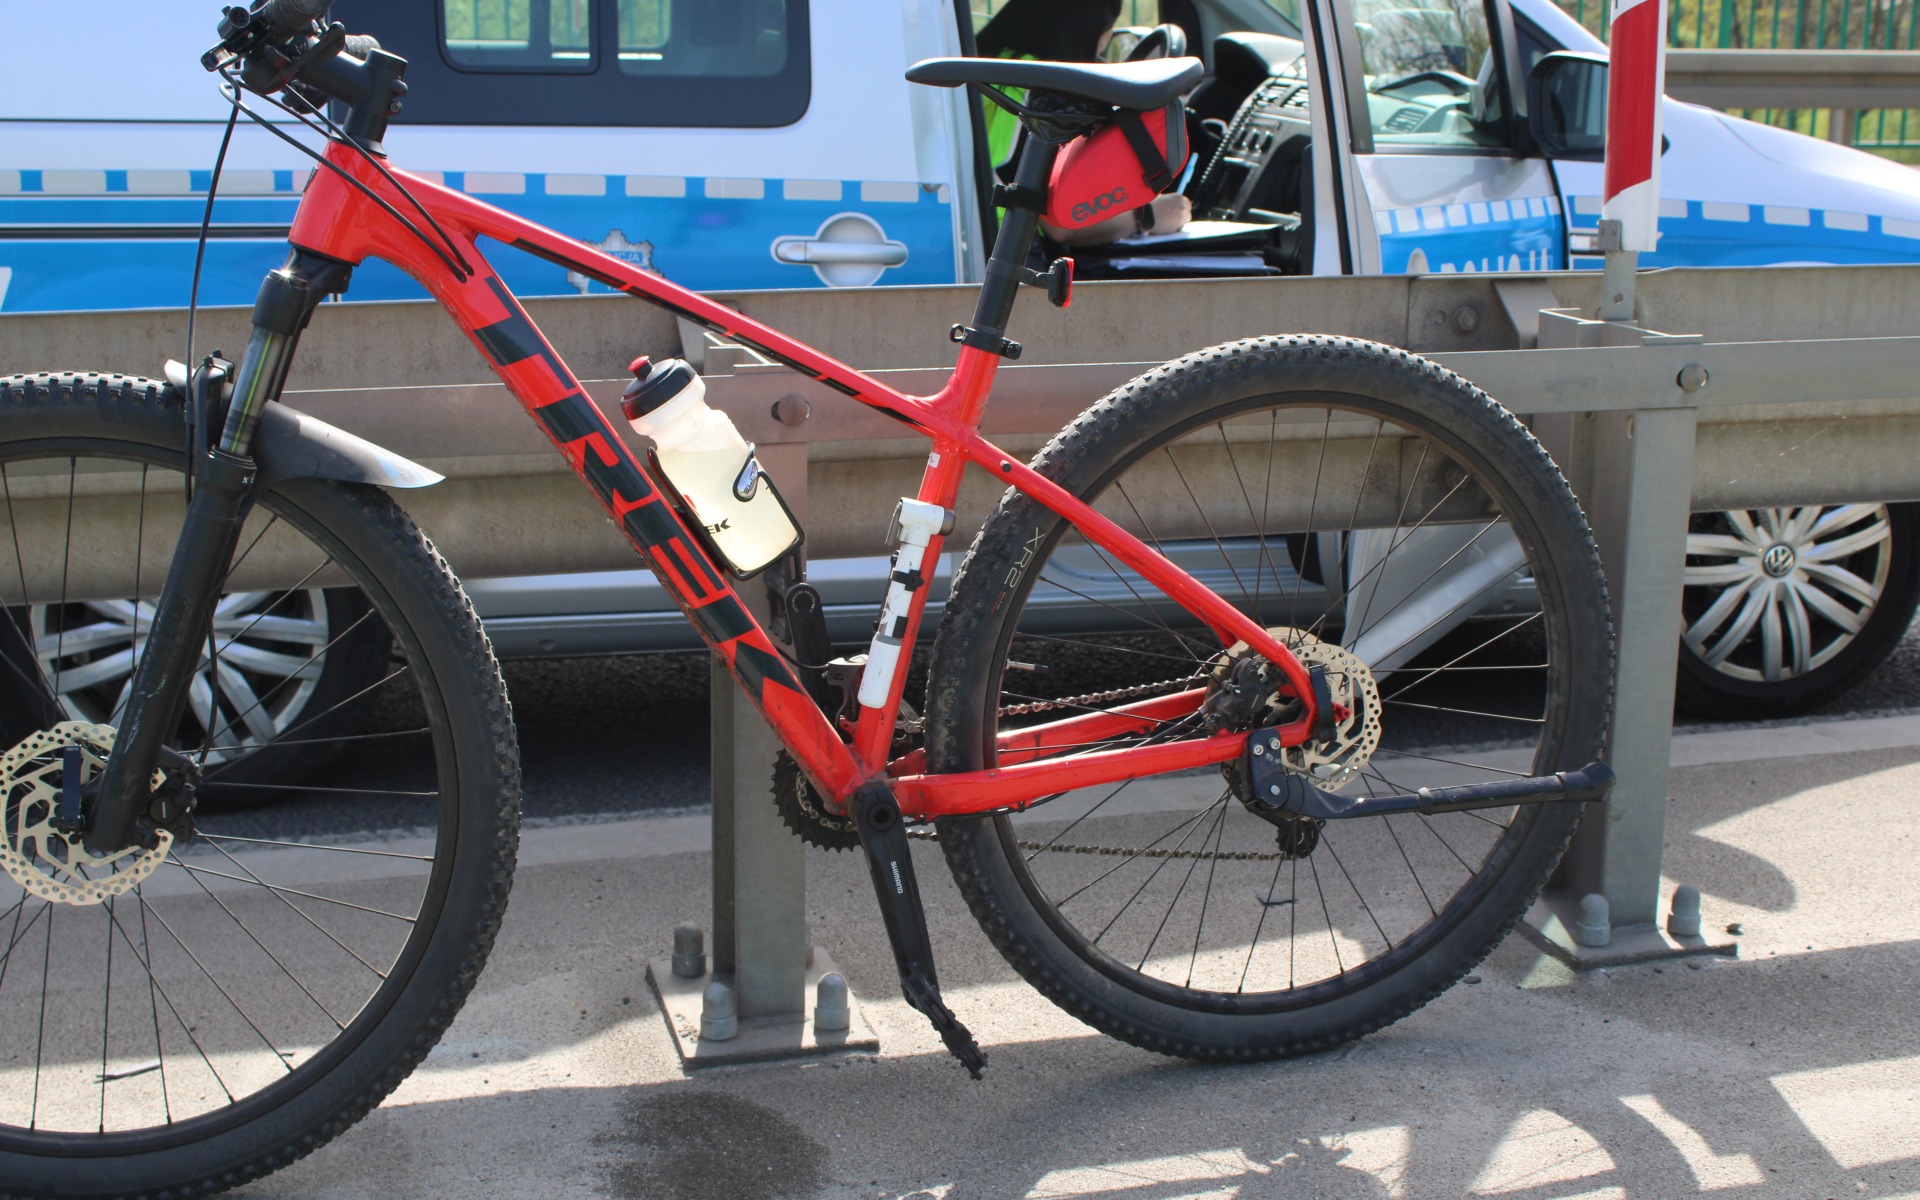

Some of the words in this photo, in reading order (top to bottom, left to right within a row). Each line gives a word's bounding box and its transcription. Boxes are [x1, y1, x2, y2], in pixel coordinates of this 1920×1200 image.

[474, 275, 808, 700] TREK
[704, 517, 732, 535] EK
[1004, 526, 1046, 588] XR2
[890, 860, 904, 894] SHIMANO
